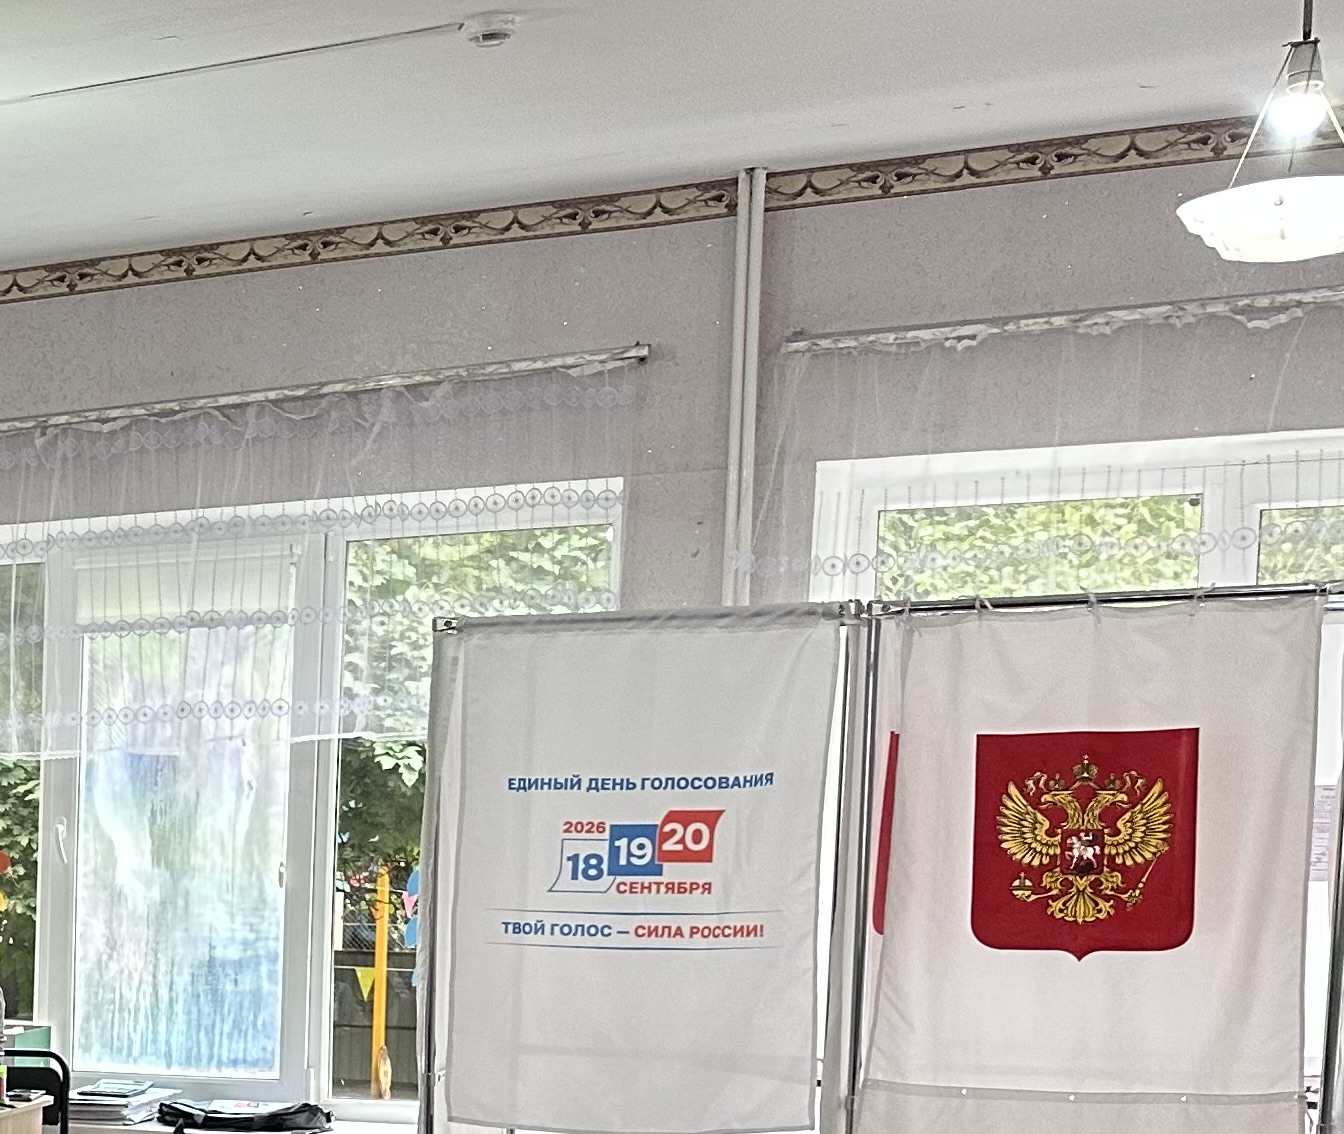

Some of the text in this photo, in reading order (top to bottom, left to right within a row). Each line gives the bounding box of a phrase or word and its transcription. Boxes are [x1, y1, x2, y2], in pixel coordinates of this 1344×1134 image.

[507, 772, 774, 793] ЕДИНЫЙ ДЕНЬ ГОЛОСОВАНИЯ
[562, 820, 606, 834] 2026
[566, 822, 711, 881] 18 19 20
[615, 881, 713, 895] СЕНТЯБРЯ
[502, 920, 545, 937] ТВОЙ
[550, 922, 613, 938] ГОЛОС
[634, 924, 685, 939] СИЛА
[689, 924, 765, 939] РОССИИ!
